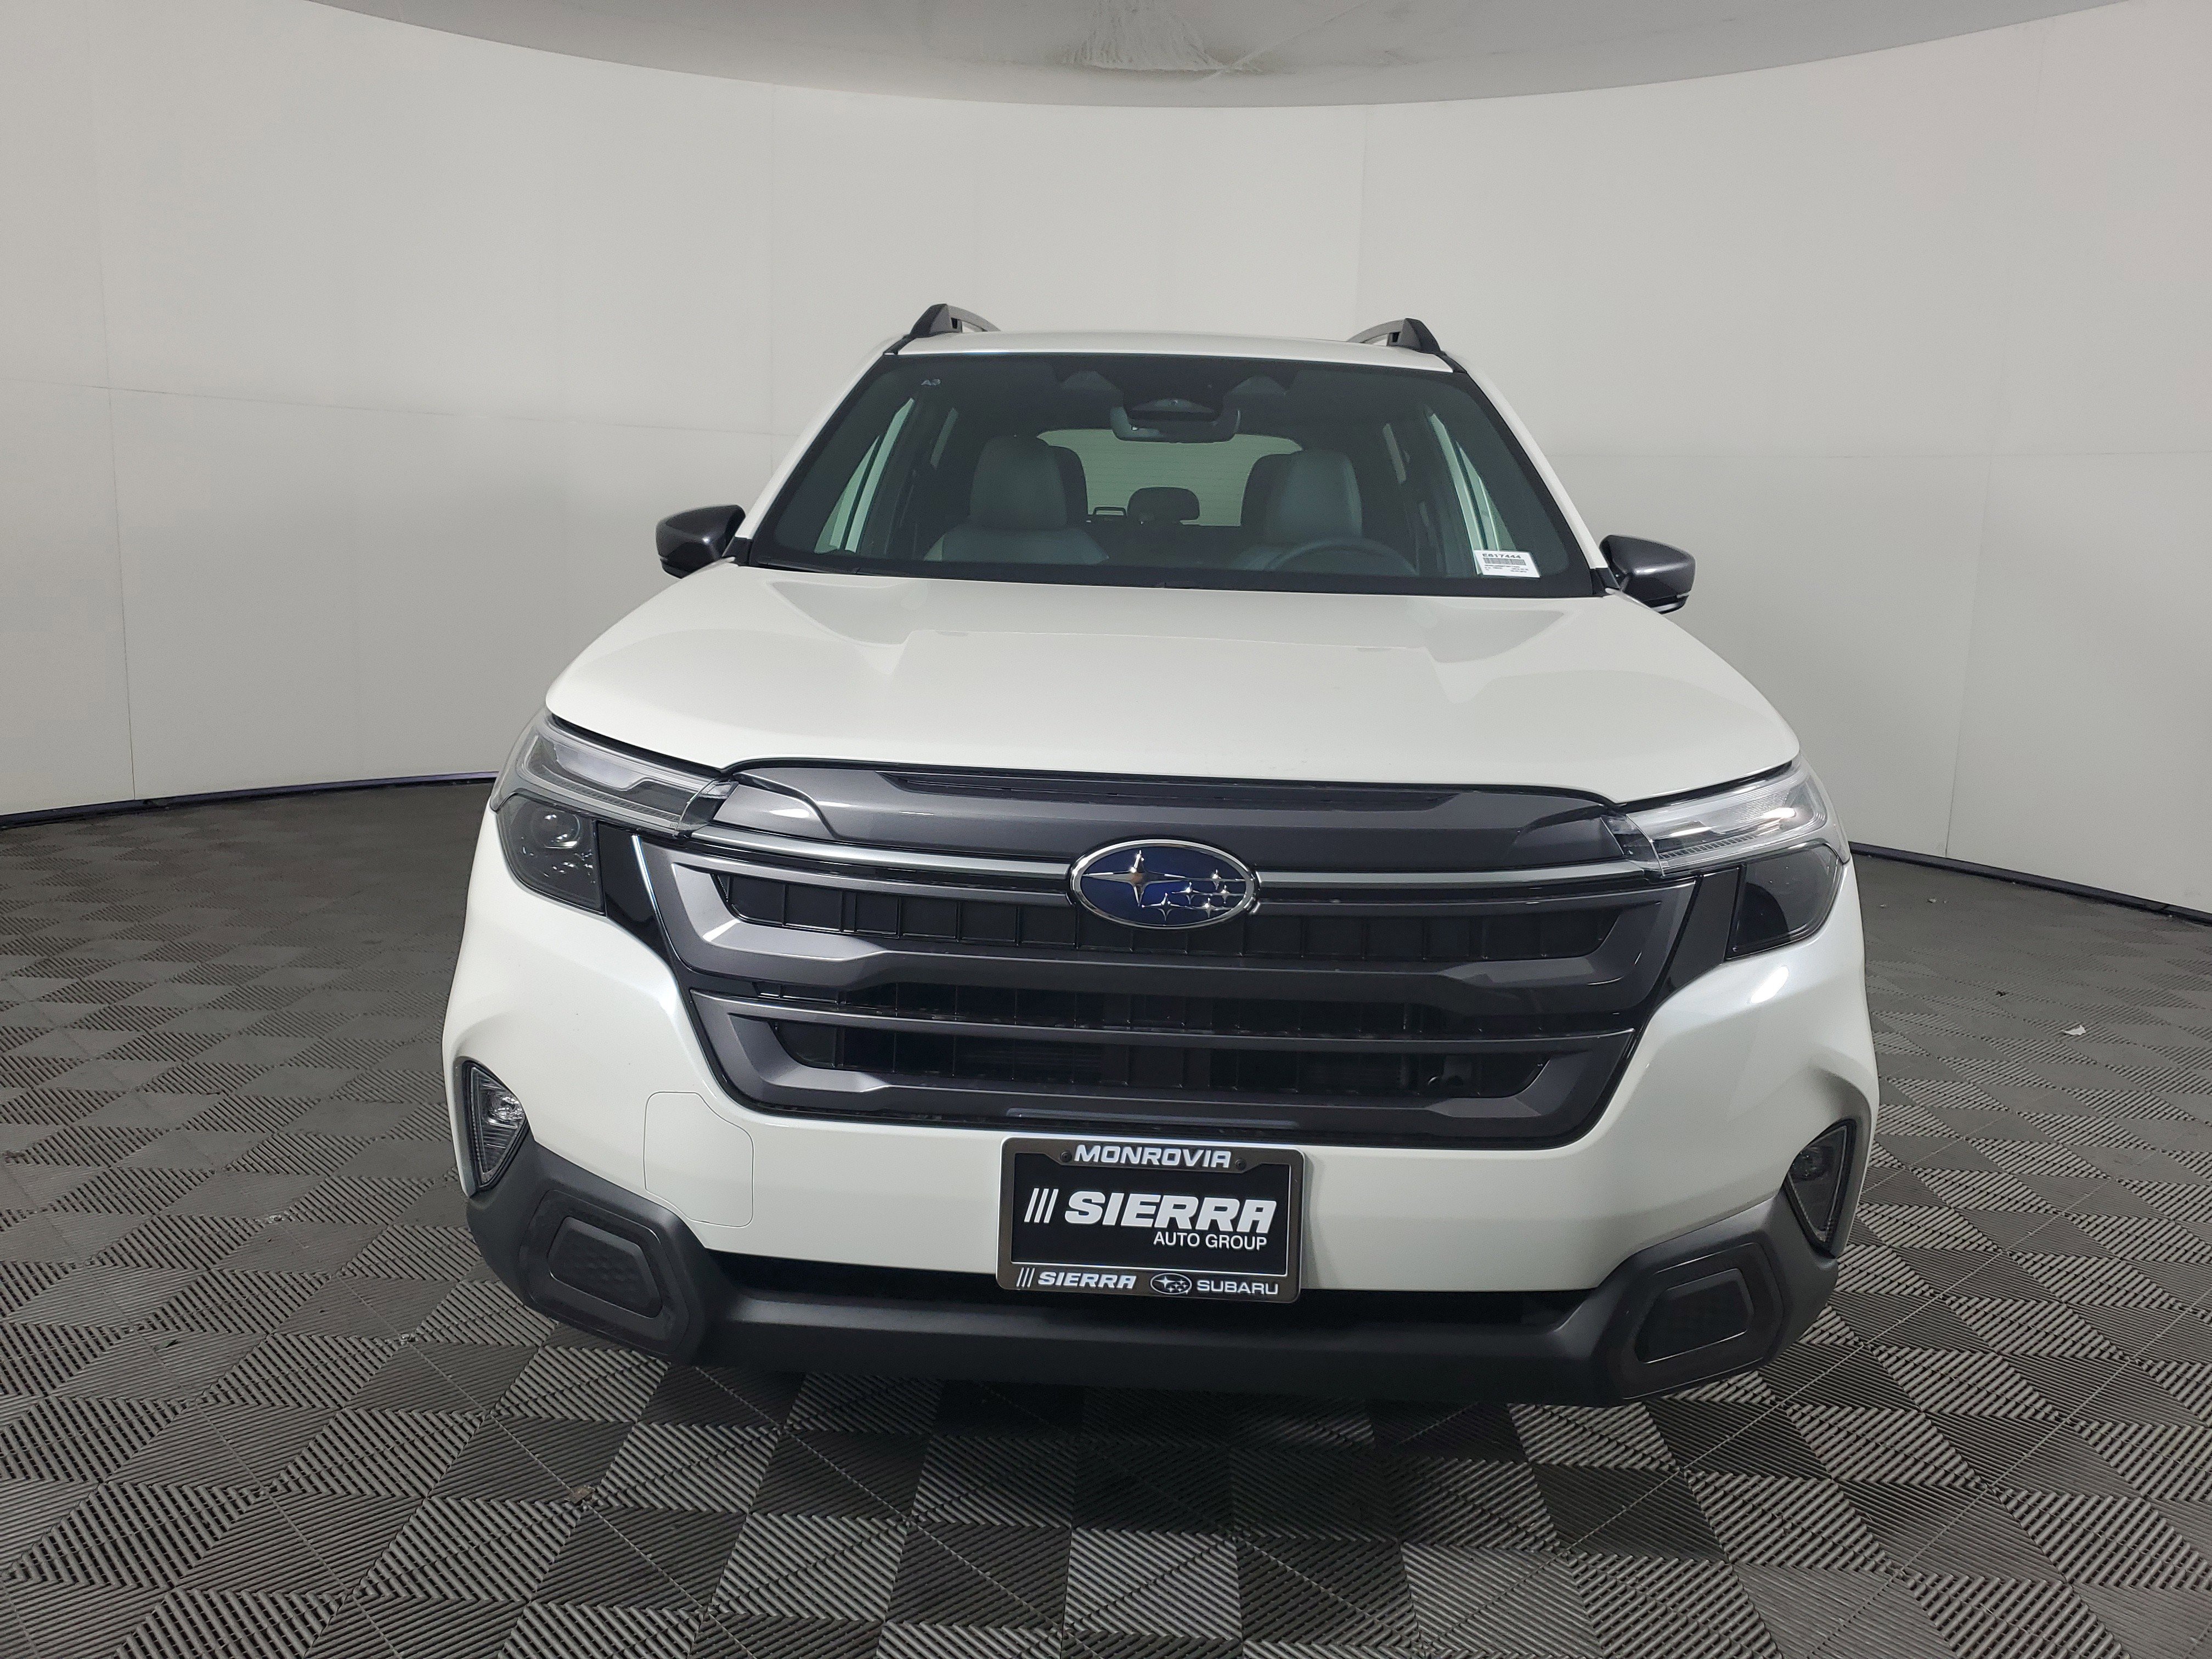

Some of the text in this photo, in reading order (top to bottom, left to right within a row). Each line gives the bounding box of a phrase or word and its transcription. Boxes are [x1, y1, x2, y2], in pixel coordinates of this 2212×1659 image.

[1074, 1145, 1231, 1168] MONROVIA
[1064, 1191, 1277, 1233] SIERRA
[1153, 1232, 1267, 1251] AUTO GROUP
[1037, 1271, 1137, 1289] SIERRA
[1197, 1280, 1279, 1295] SUBARU
